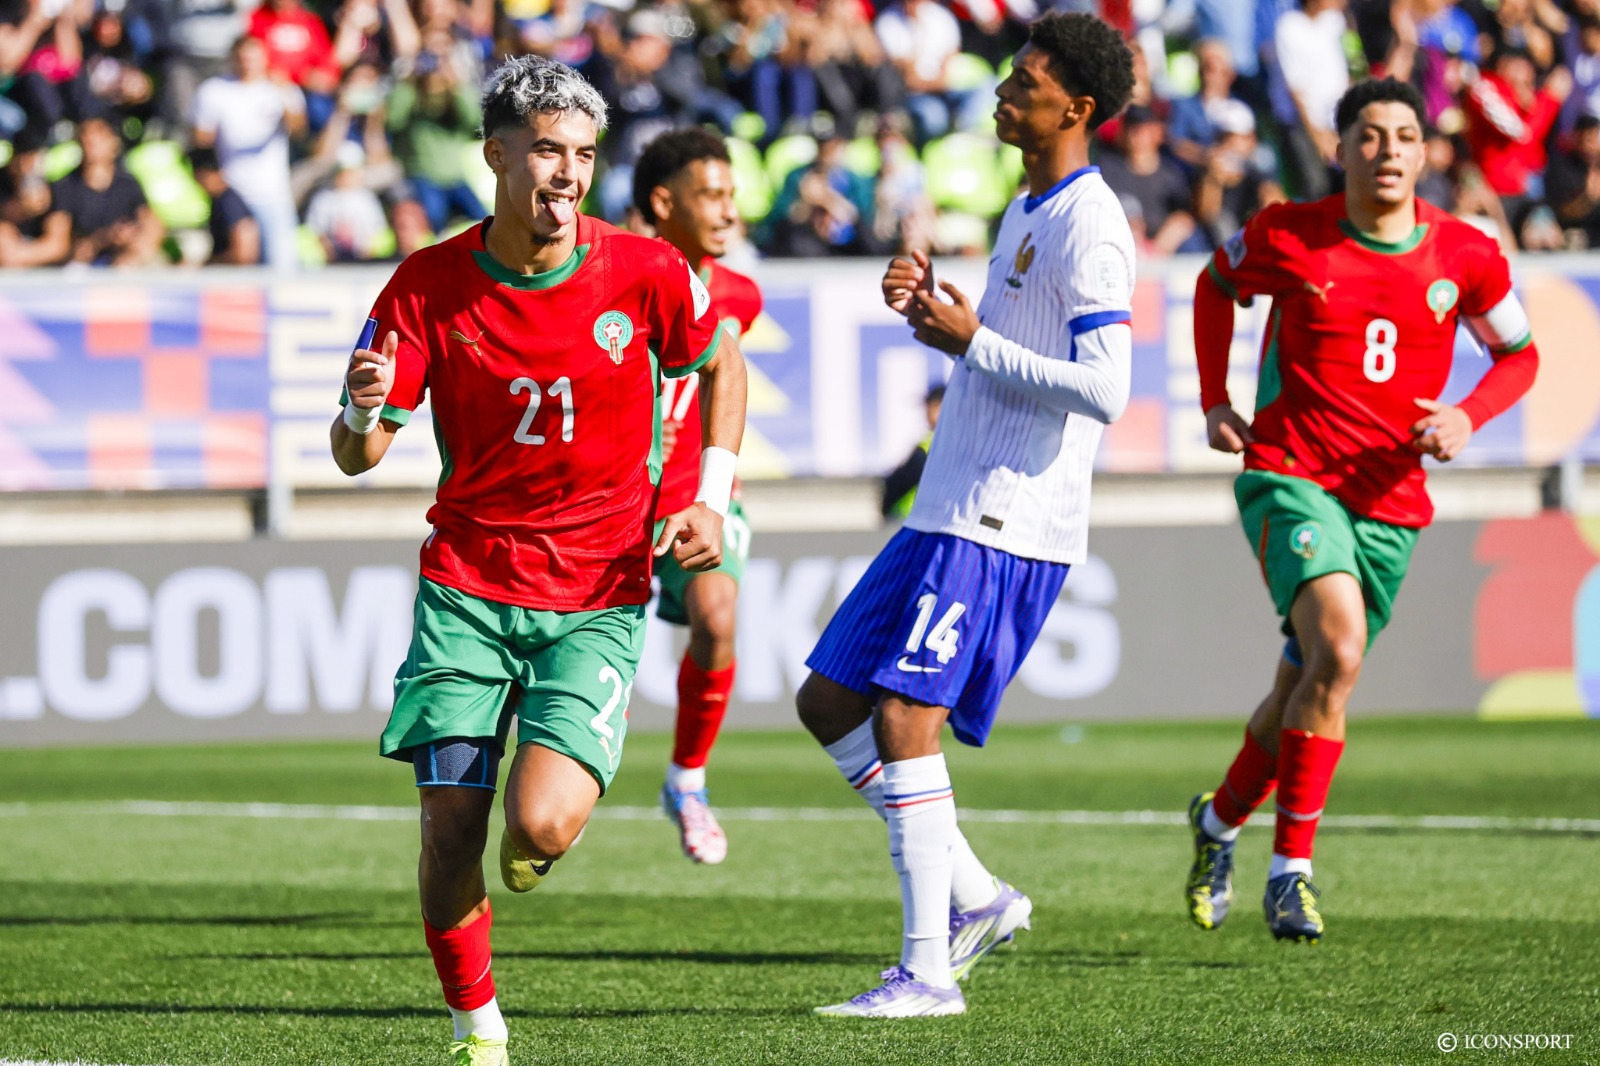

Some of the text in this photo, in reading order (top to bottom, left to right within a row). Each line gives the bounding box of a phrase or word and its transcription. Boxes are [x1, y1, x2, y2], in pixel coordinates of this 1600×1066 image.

[1363, 318, 1398, 383] 8
[509, 376, 574, 446] 21
[906, 592, 966, 665] 14
